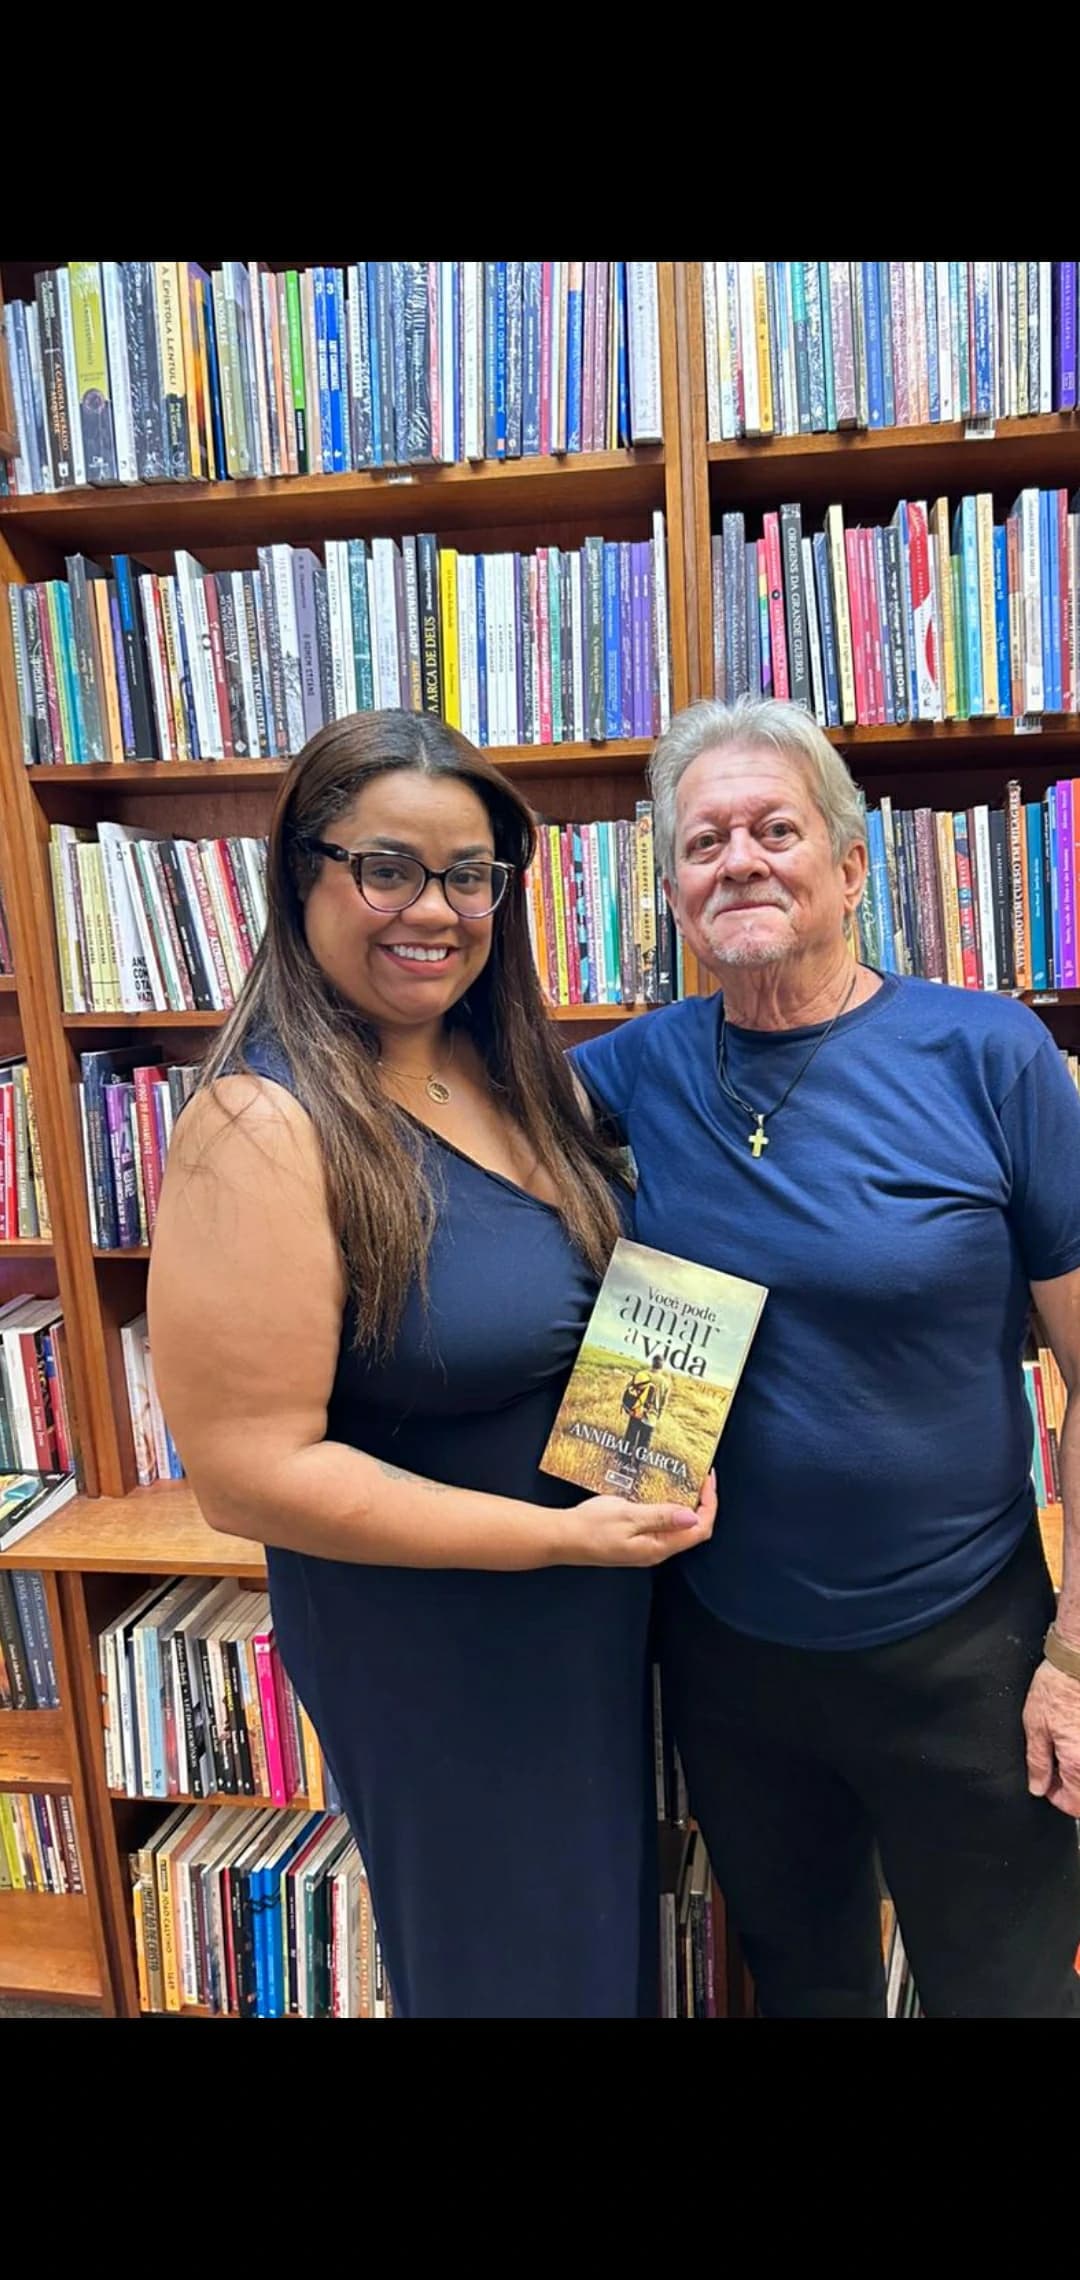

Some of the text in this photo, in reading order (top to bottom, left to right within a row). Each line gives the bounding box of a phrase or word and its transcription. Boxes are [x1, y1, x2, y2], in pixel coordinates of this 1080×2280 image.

[326, 281, 335, 294] 3
[161, 266, 177, 386] A EPÍSTOLA LENTULI
[497, 331, 505, 359] CURSO
[405, 547, 416, 583] OUTRO
[787, 527, 804, 682] ORIGENS DA GRANDE GUERRA
[225, 651, 238, 664] A
[303, 640, 313, 666] HOMEM
[425, 615, 439, 715] A ARCA DE DEUS
[253, 674, 267, 735] TIM CHESTER
[1012, 863, 1022, 902] CURSO
[618, 1291, 721, 1349] amar
[648, 1286, 717, 1323] Você pode
[623, 1327, 708, 1378] a vida
[569, 1421, 634, 1457] ANNÍBAL
[635, 1447, 688, 1478] GARCIA
[143, 1887, 155, 1929] IMITAÇÃO
[148, 1941, 158, 1972] CRISTO
